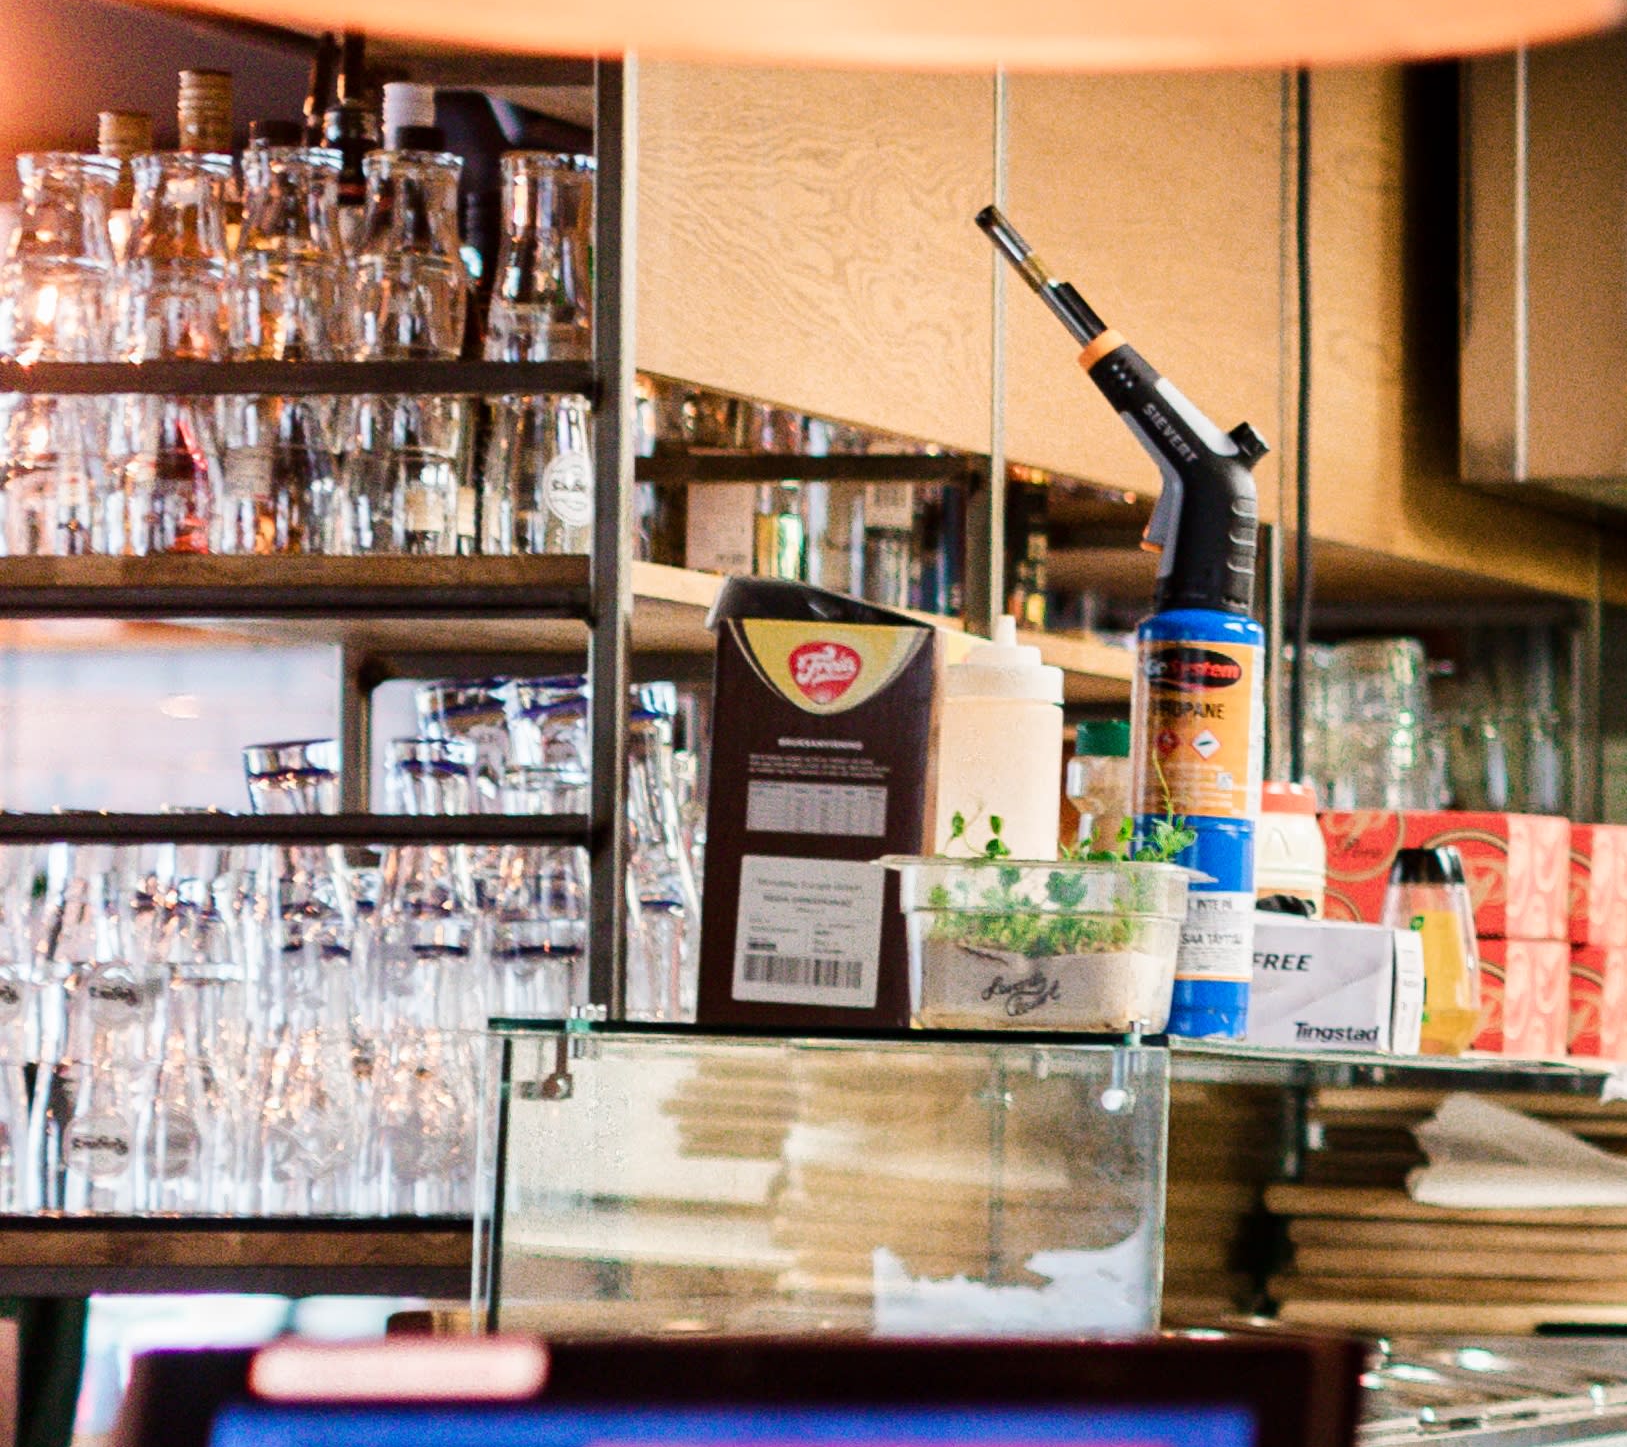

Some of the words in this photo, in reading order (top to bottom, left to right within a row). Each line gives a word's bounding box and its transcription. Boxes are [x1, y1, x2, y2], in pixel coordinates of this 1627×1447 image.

[1142, 402, 1200, 464] SIEVERT
[1253, 951, 1313, 972] FREE
[1294, 1020, 1380, 1044] Tingstad
